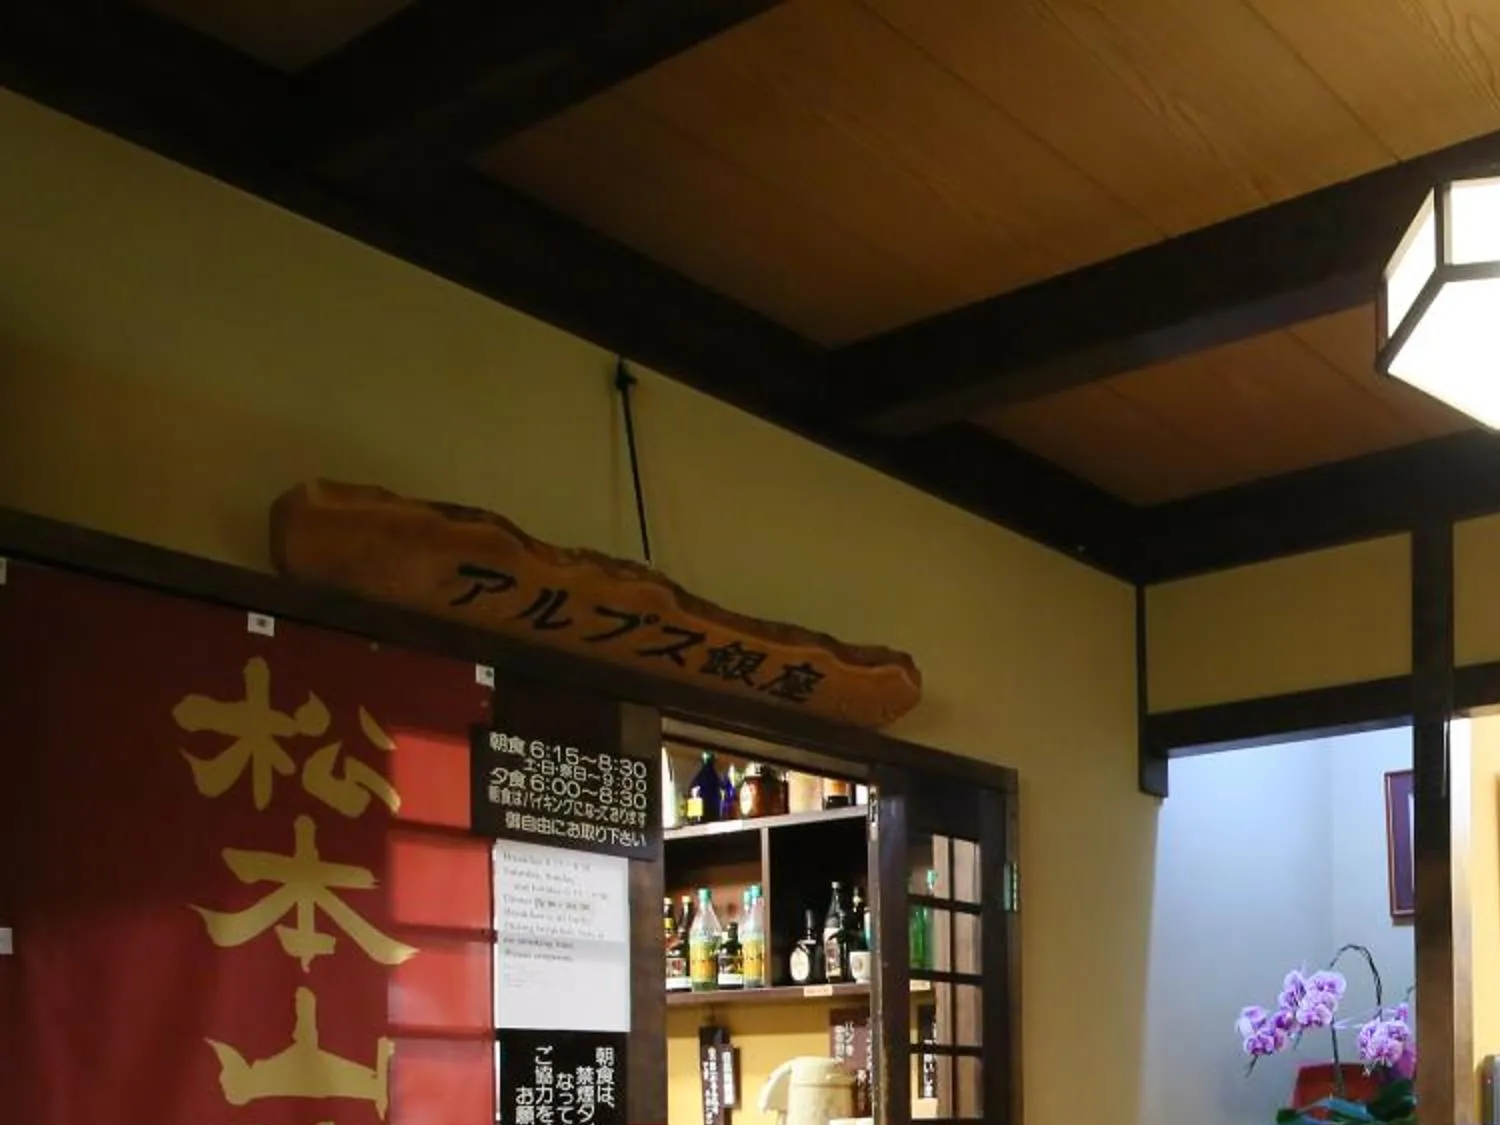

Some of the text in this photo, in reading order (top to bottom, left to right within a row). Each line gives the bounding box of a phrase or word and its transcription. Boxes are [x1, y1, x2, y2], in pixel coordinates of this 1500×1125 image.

[451, 564, 825, 702] アルプス銀座
[489, 731, 526, 757] 朝食
[490, 767, 527, 789] 夕食
[595, 1047, 616, 1109] 朝食は、
